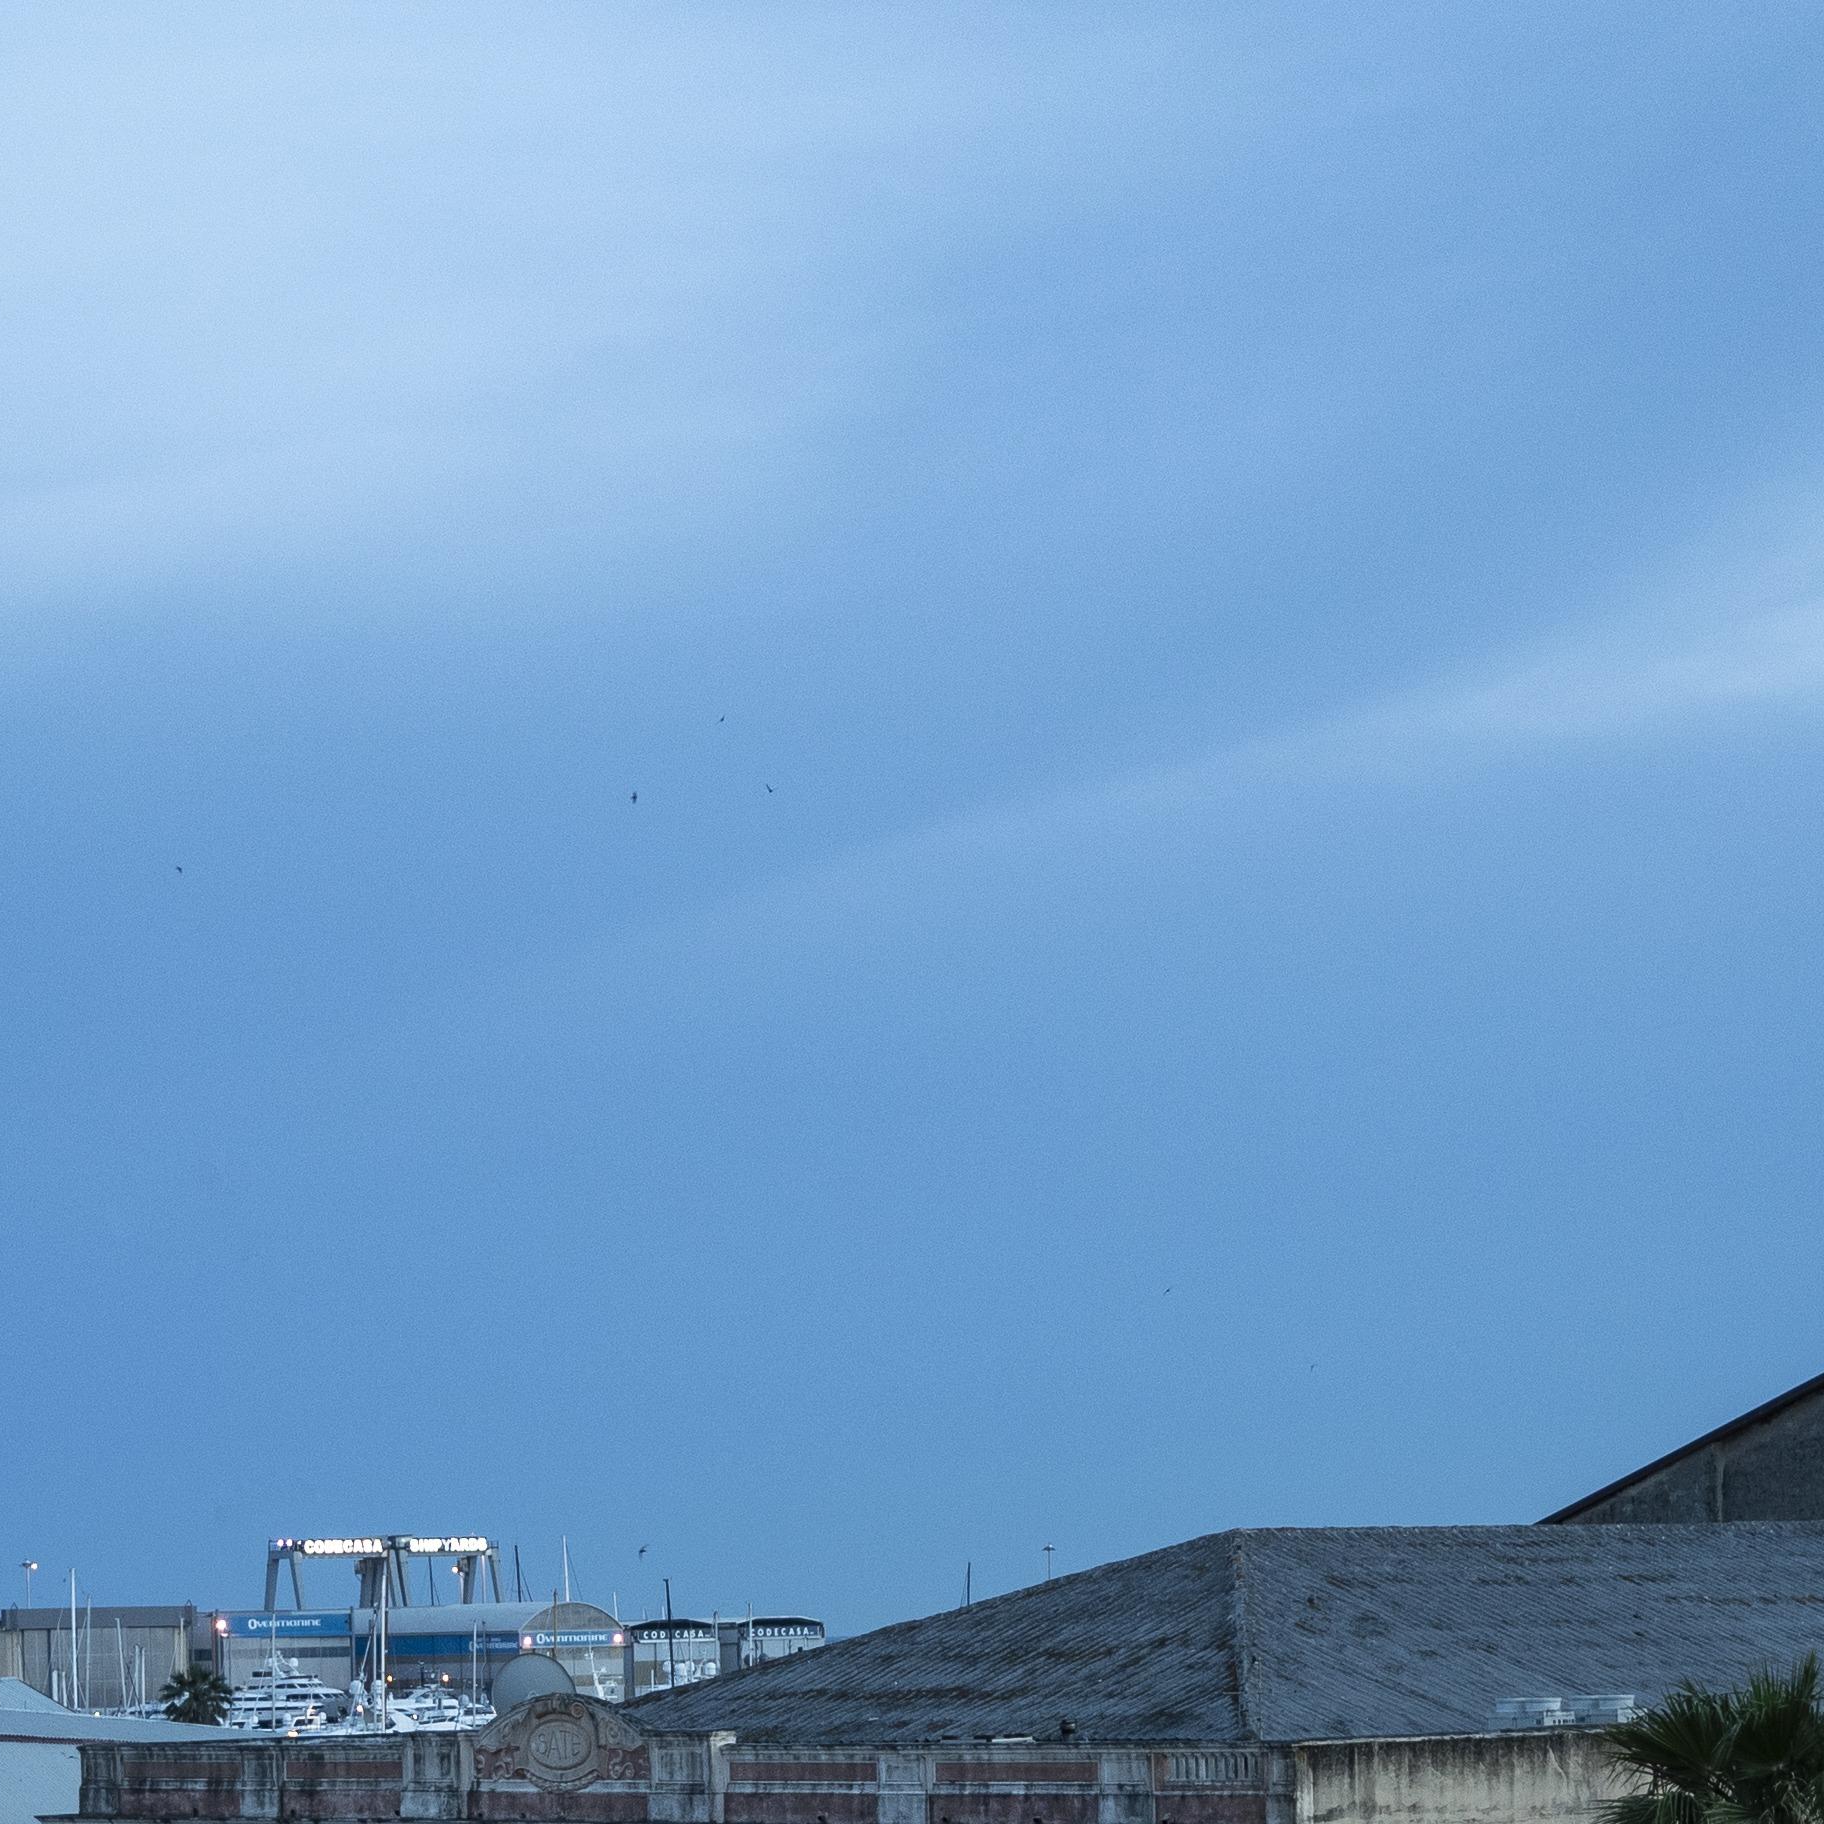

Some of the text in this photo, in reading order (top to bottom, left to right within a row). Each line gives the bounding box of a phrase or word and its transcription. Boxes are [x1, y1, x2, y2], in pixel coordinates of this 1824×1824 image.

[304, 1536, 488, 1554] CODECASA SHIPYARDS
[643, 1628, 704, 1640] CODCASA
